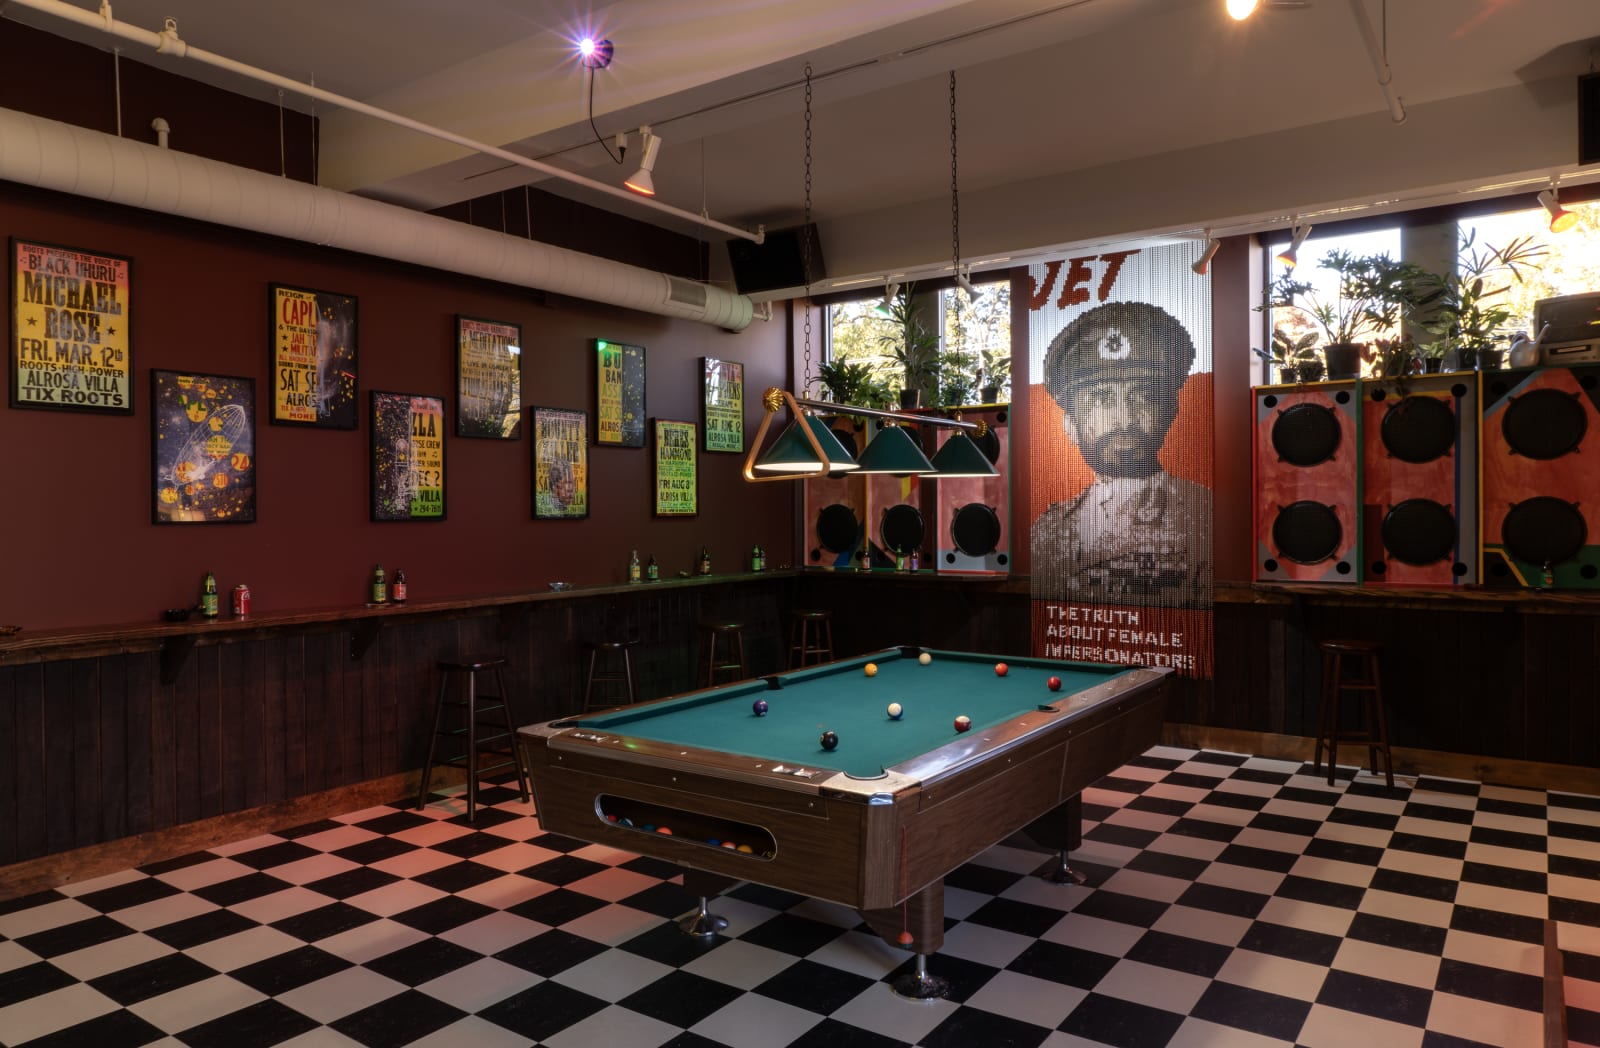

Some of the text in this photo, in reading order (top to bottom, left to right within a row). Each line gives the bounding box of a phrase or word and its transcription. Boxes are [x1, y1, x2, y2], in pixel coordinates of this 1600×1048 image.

[28, 253, 117, 282] BLACK UHURU
[23, 270, 122, 315] MICHAEL
[278, 289, 304, 299] REIGN
[44, 306, 101, 344] ROSE
[20, 338, 123, 368] FRI. MAR. 12th
[20, 360, 124, 378] ROOTS HIGH POWER
[27, 370, 119, 393] ALROSA VILLA
[280, 368, 301, 392] SAT
[22, 386, 123, 406] TIX ROOTS
[707, 418, 718, 431] SAT
[728, 433, 740, 444] VILLA
[671, 479, 685, 490] AUG
[420, 489, 441, 503] VILLA
[1046, 606, 1139, 626] THE TRUTH
[1046, 623, 1183, 648] ABOUT FEMALE
[1045, 643, 1196, 669] IMPERSONATORS
